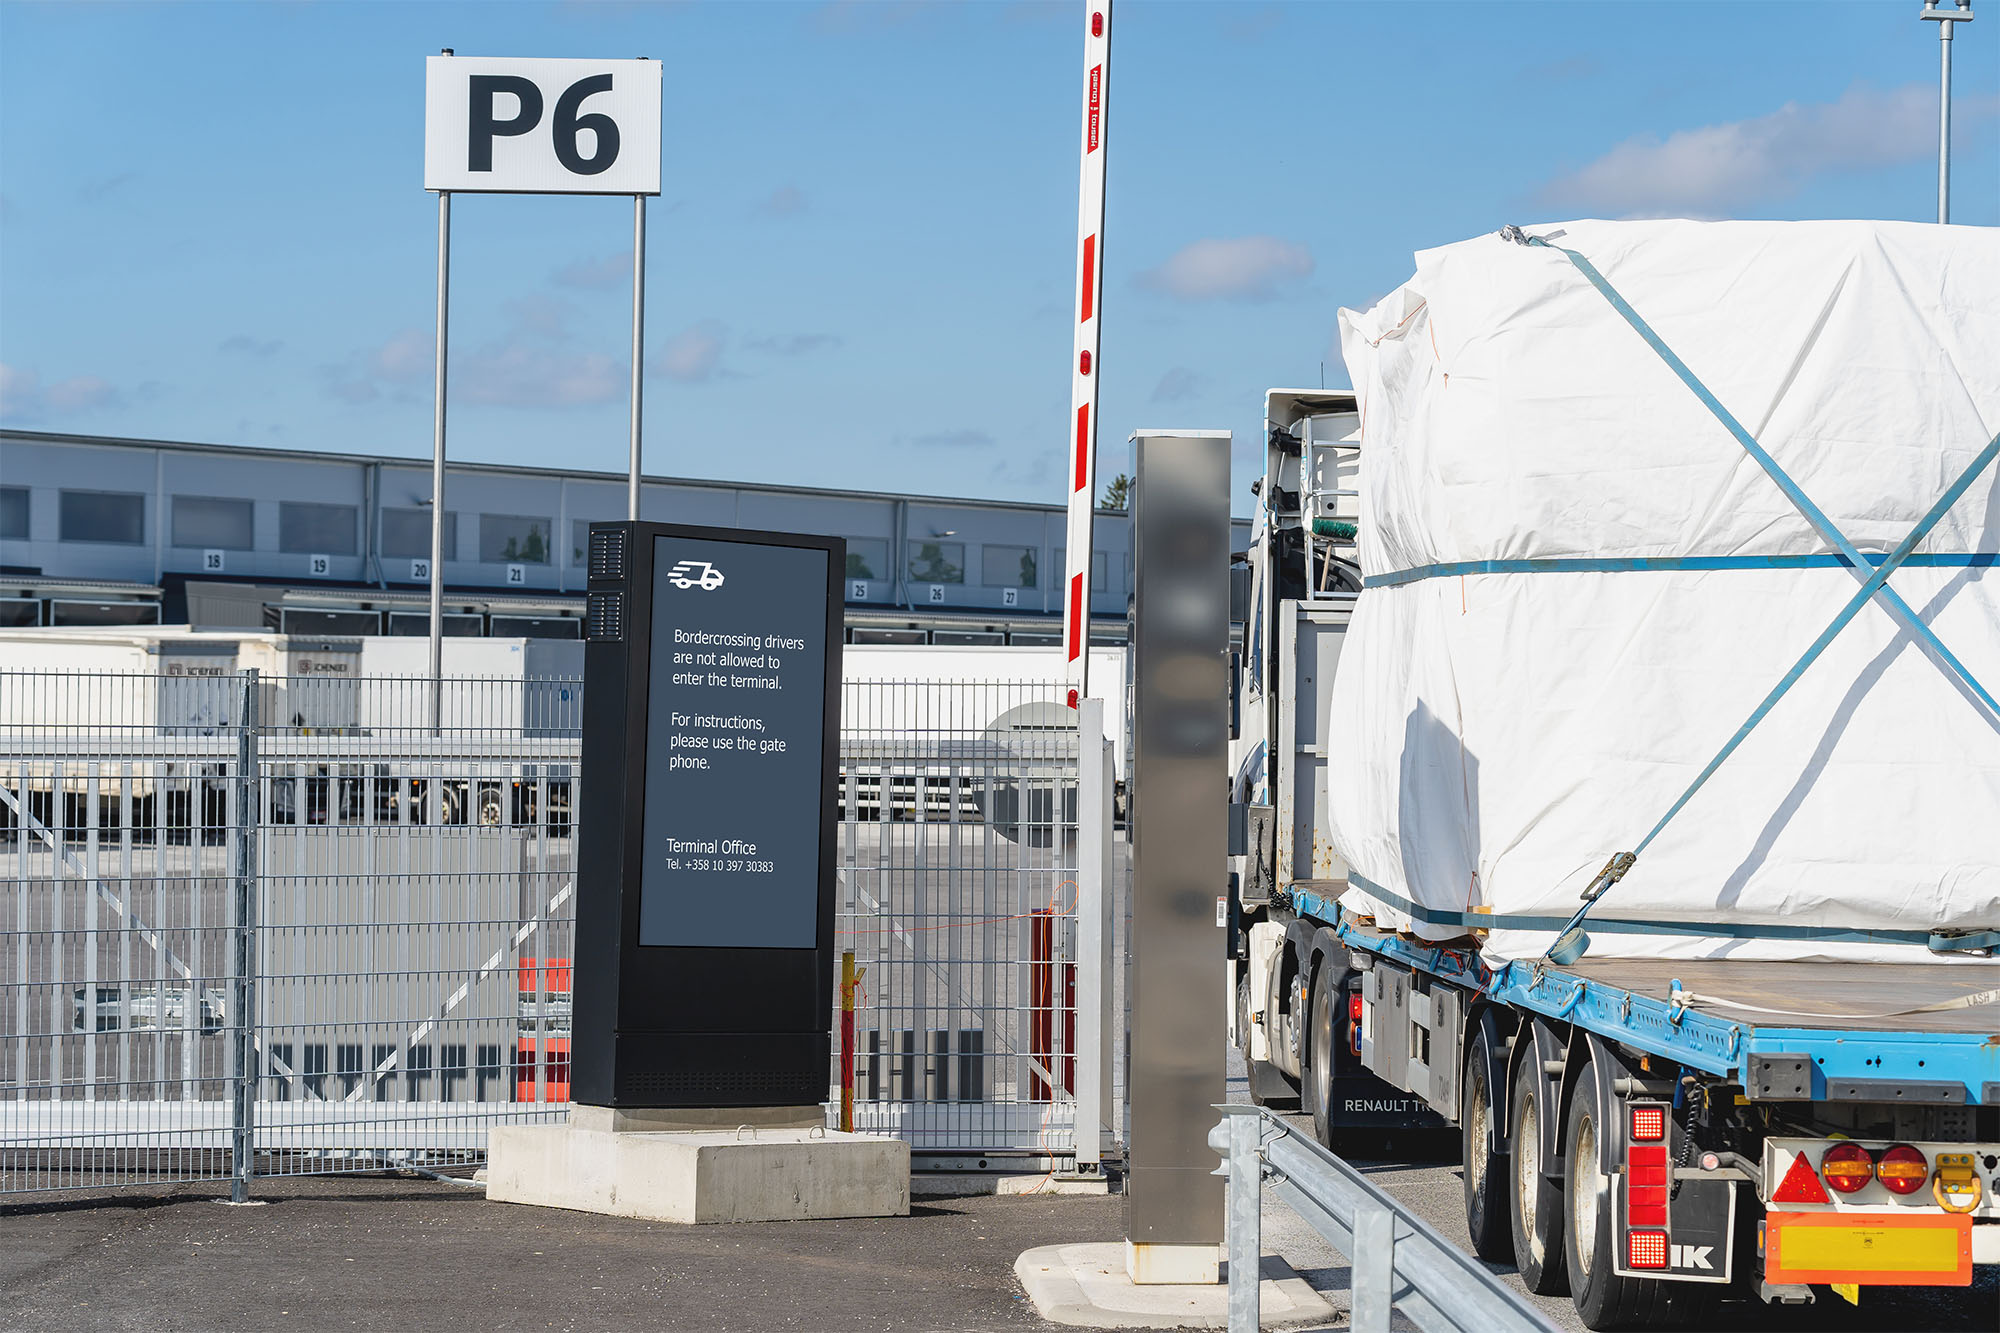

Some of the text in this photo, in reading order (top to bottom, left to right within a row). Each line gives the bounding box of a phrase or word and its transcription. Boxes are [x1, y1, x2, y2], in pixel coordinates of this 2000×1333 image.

[468, 73, 621, 176] P6
[207, 554, 221, 569] 18
[314, 559, 327, 574] 19
[414, 563, 427, 578] 20
[511, 568, 522, 582] 21
[855, 584, 866, 598] 25
[932, 588, 943, 601] 26
[1006, 592, 1016, 604] 27
[674, 629, 805, 650] Bordercrossing drivers
[673, 652, 780, 669] are not allowed to
[672, 672, 782, 690] enter the terminal.
[671, 712, 766, 733] For instructions,
[670, 733, 786, 755] please use the gate
[669, 753, 711, 771] phone.
[666, 838, 757, 855] Terminal Office
[666, 858, 774, 873] Tel. +358 10 397 30383
[1966, 991, 1990, 1007] LASH
[1345, 1099, 1408, 1112] RENAULT
